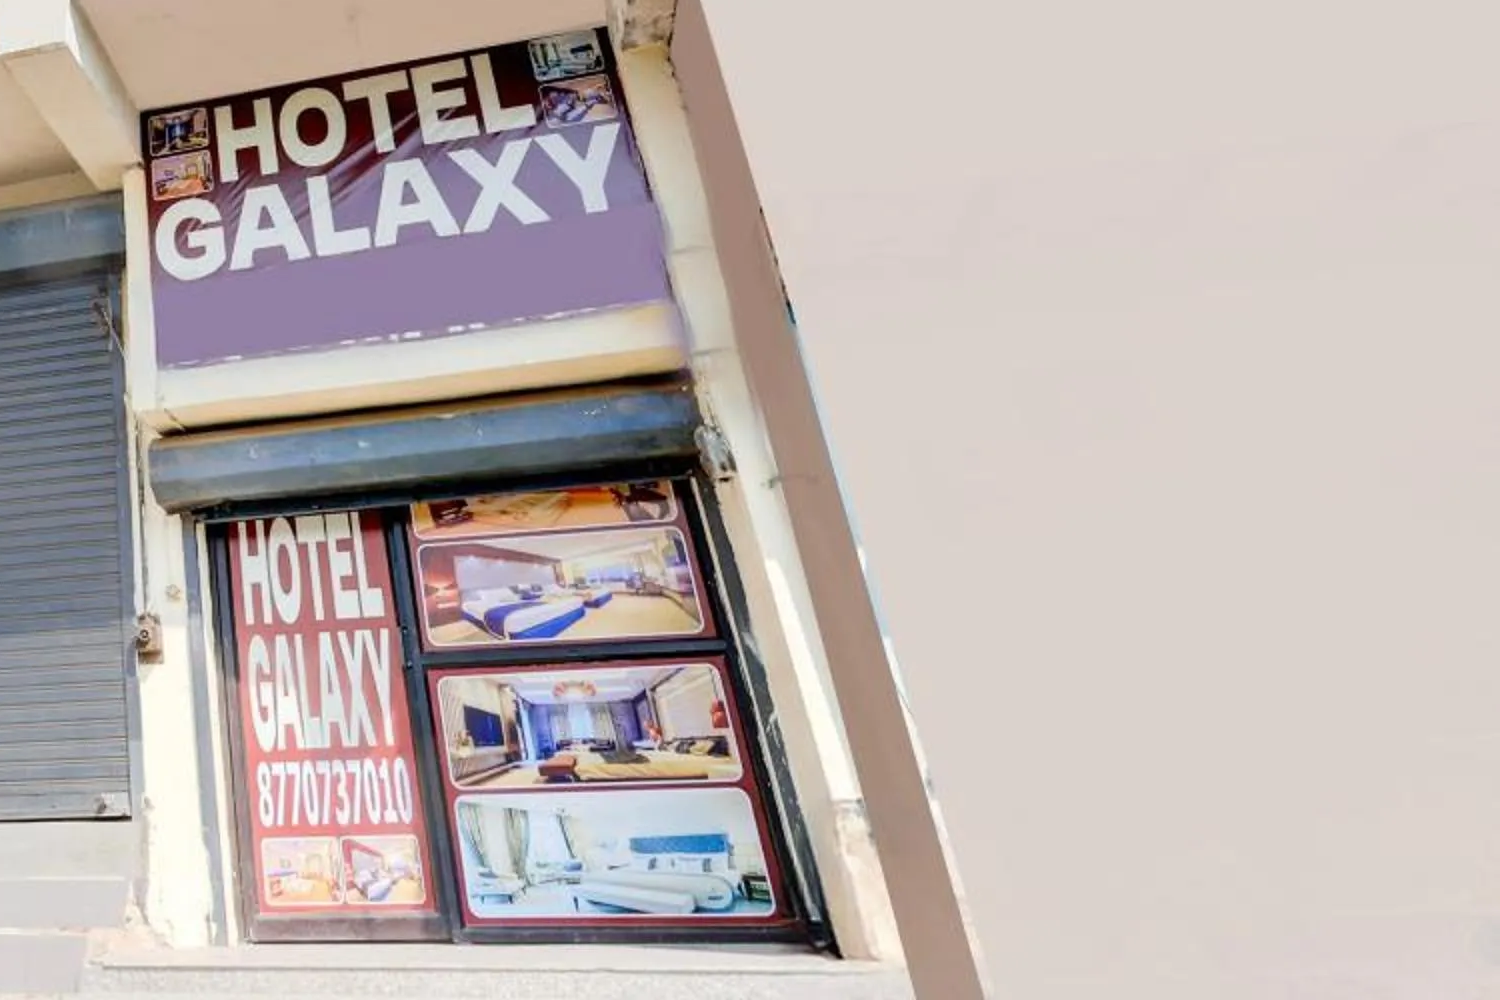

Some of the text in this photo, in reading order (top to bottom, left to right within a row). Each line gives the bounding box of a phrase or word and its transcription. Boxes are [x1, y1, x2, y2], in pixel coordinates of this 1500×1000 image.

[214, 53, 536, 183] HOTEL
[155, 122, 621, 281] GALAXY
[238, 511, 385, 625] HOTEL
[247, 628, 396, 752] GALAXY
[256, 757, 413, 828] 8770737010
